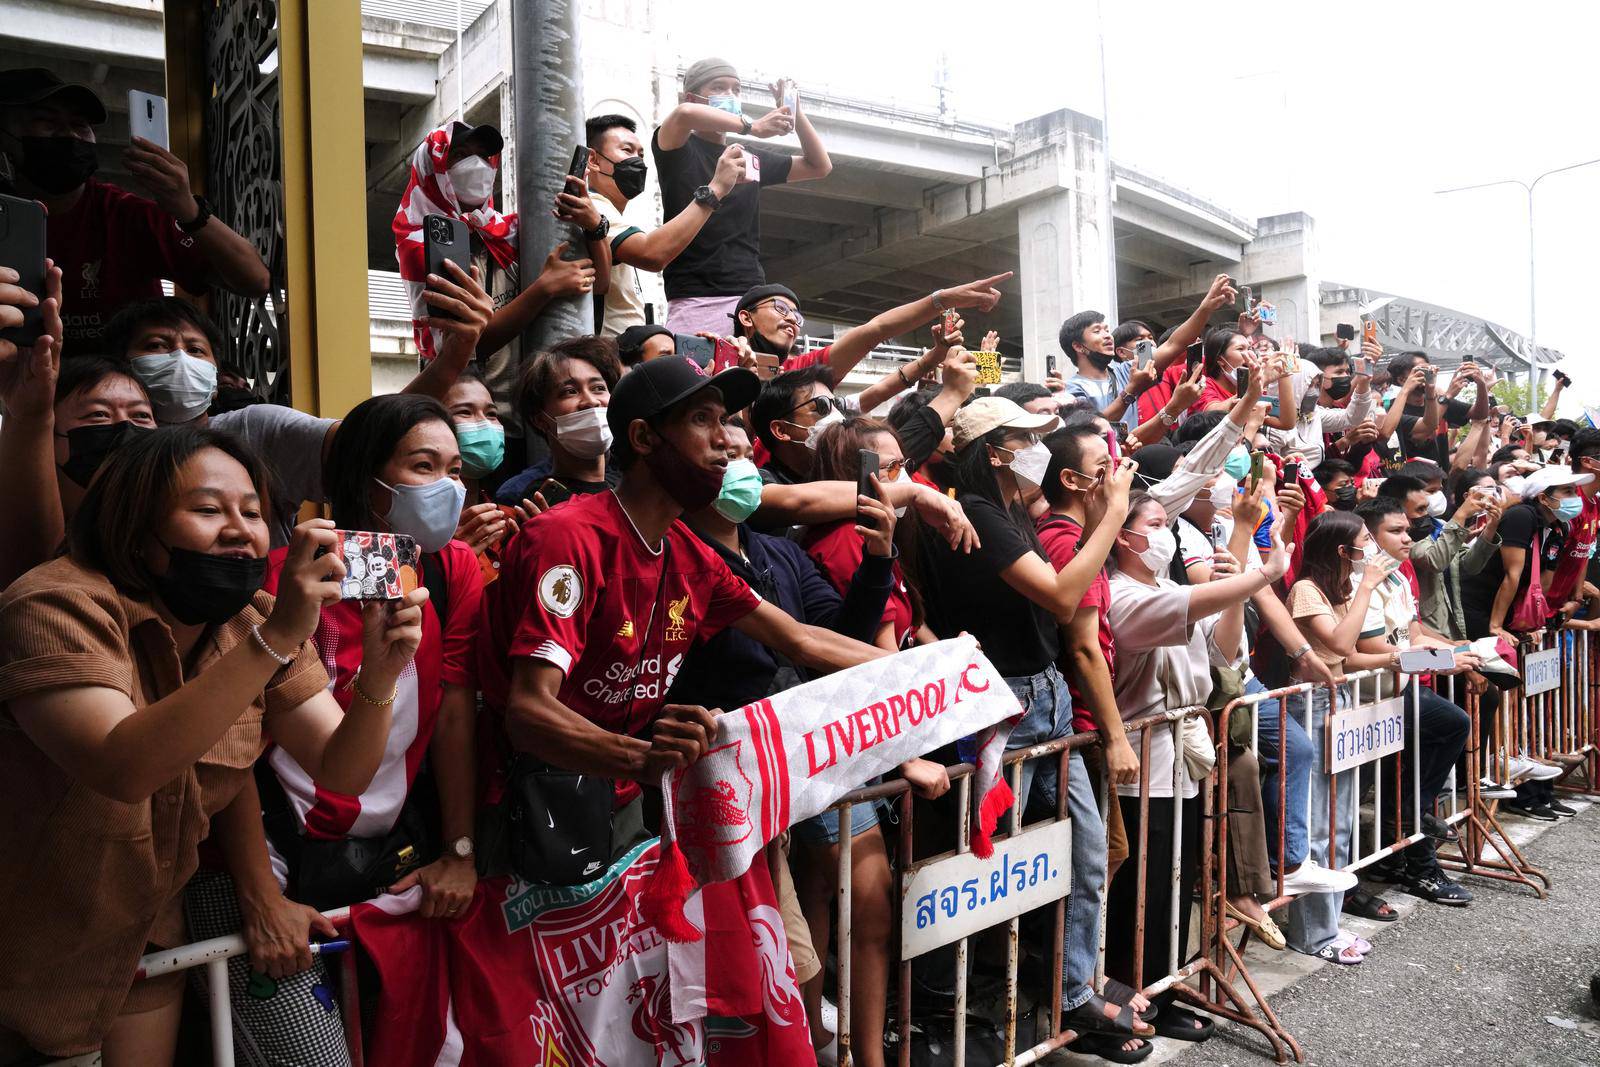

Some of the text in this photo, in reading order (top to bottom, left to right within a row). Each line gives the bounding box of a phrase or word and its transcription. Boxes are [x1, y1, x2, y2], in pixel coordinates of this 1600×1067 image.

[802, 678, 947, 778] LIVERPOOL
[1337, 715, 1402, 761] ส่วนจราจร
[916, 853, 1058, 930] สจร.ฝรภ.
[573, 930, 663, 1004] FOOBALL
